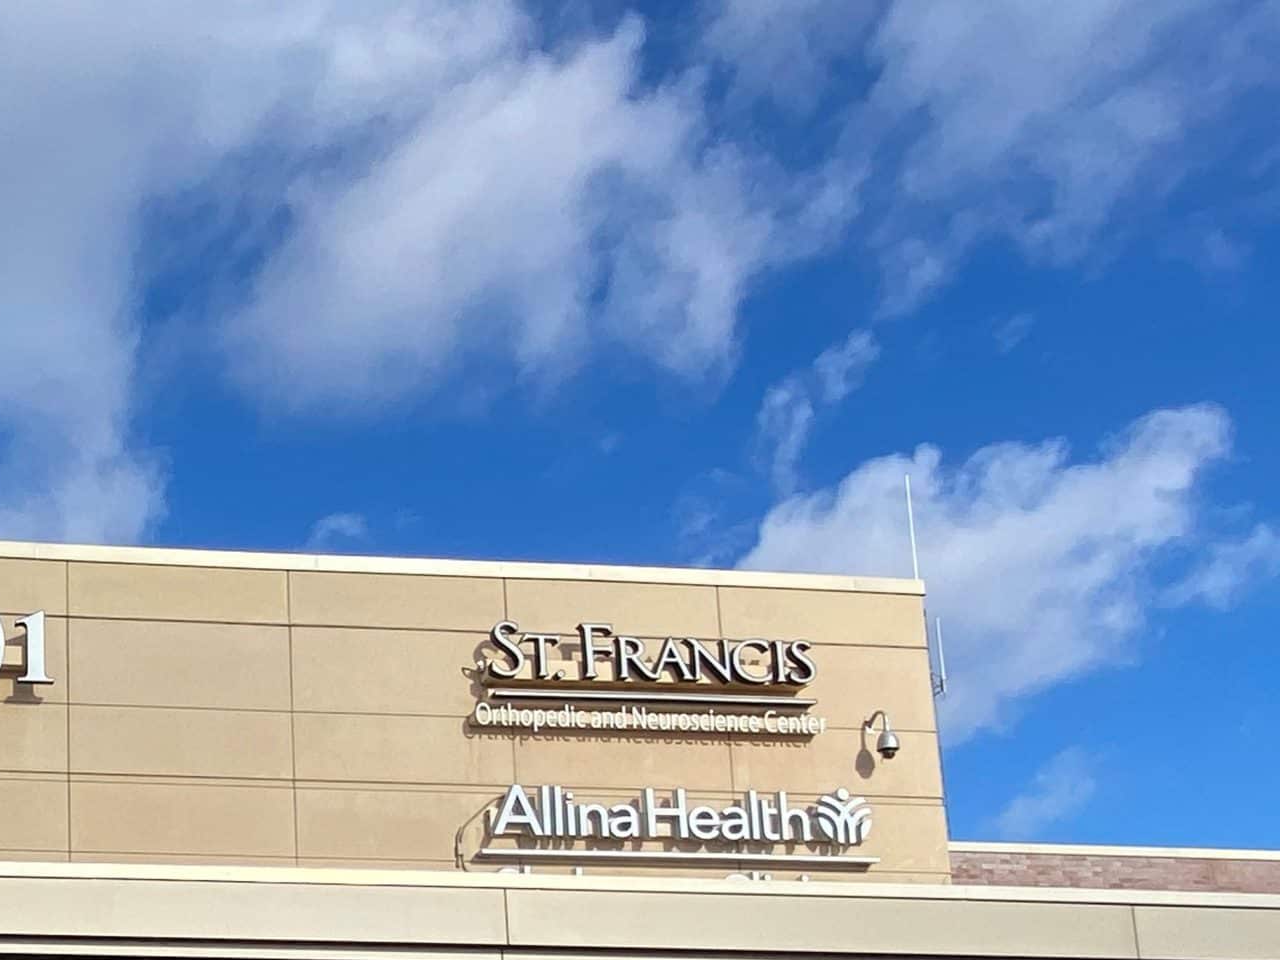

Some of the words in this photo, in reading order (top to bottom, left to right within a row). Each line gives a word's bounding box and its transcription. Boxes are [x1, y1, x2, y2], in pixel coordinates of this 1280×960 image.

[577, 622, 817, 685] FRANCIS
[475, 702, 588, 732] Orthopedic
[591, 705, 628, 730] and
[631, 706, 760, 733] Neuroscience
[763, 710, 827, 735] Center
[494, 784, 640, 838] Allina
[642, 786, 812, 842] Health
